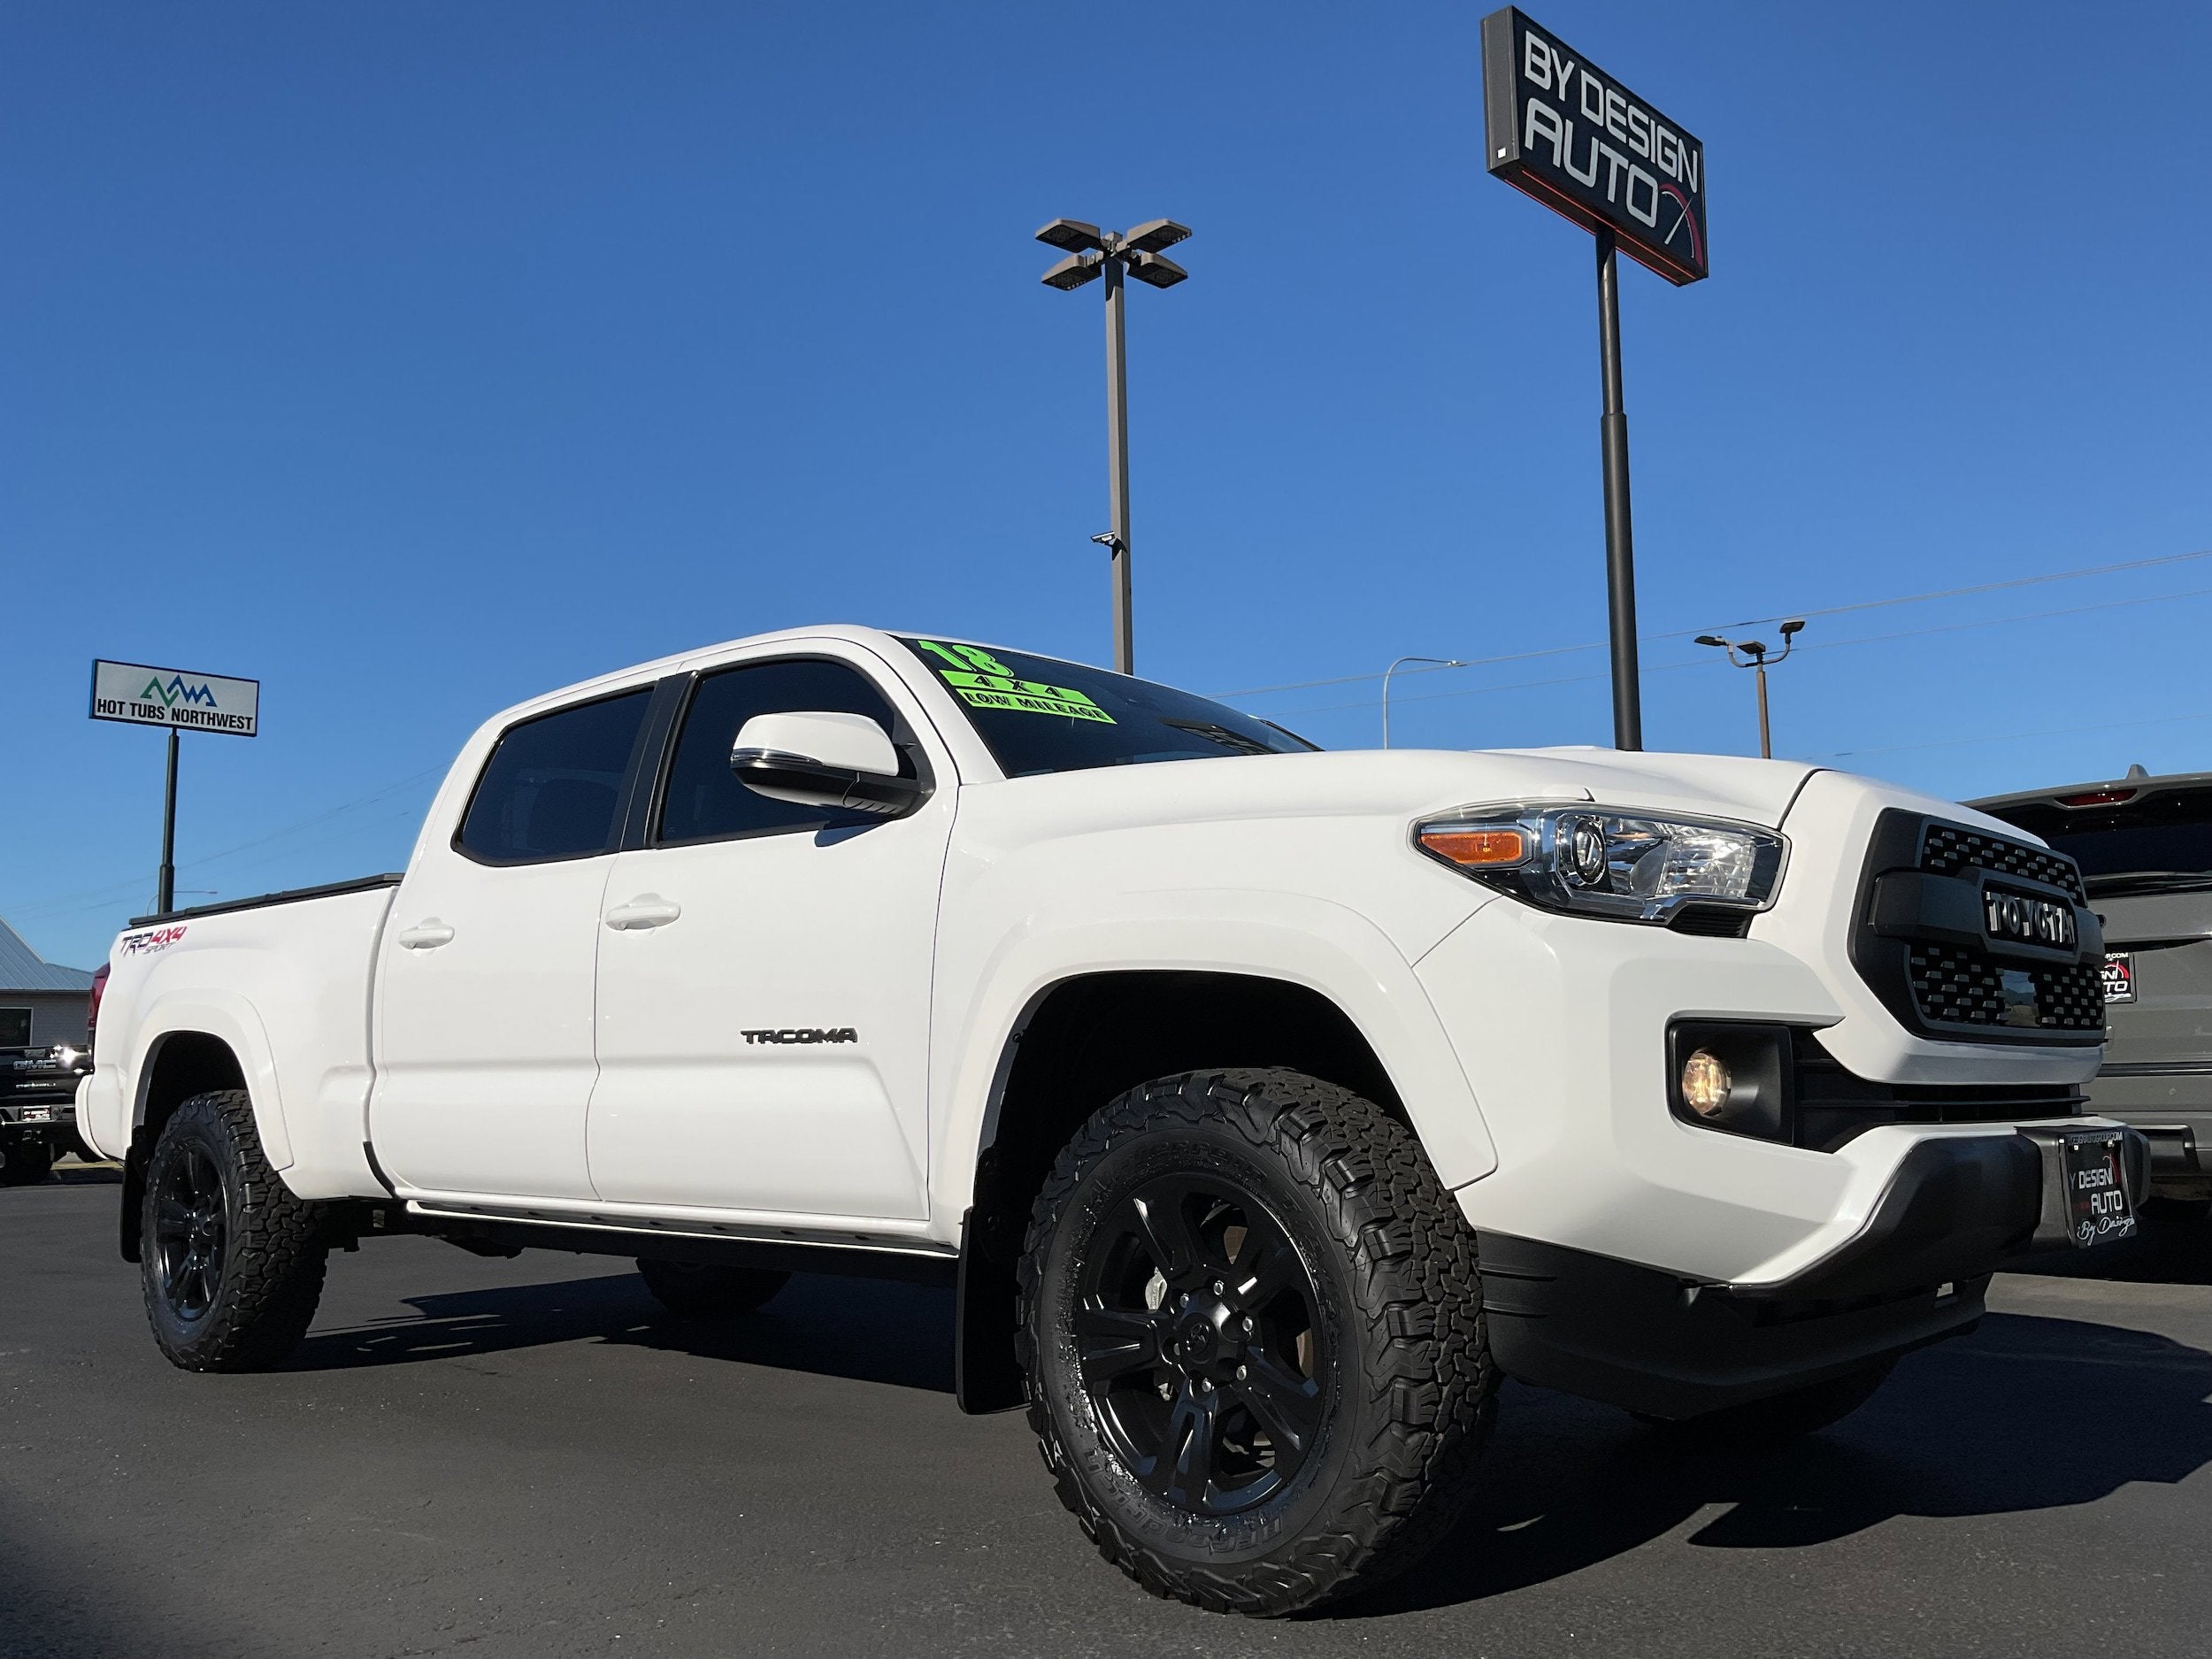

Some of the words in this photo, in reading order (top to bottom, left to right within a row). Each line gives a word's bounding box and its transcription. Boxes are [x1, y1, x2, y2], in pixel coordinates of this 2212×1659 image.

[1525, 30, 1575, 101] BY
[1580, 70, 1698, 193] DESIGN
[1525, 97, 1658, 228] AUTO
[918, 640, 1014, 678] 18
[97, 698, 126, 715] HOT
[129, 703, 165, 719] TUBS
[171, 708, 253, 730] NORTHWEST
[964, 692, 1010, 707] LOW
[1016, 697, 1110, 720] MILEAGE
[1985, 891, 2076, 944] TOYOTA
[120, 932, 153, 957] TRD
[143, 942, 175, 955] SPORT
[741, 1028, 858, 1044] TACOMA
[13, 1059, 57, 1070] GMC
[2078, 1168, 2113, 1189] DESIGN
[2091, 1190, 2123, 1214] AUTO
[2077, 1221, 2096, 1246] By
[2097, 1216, 2135, 1237] Design
